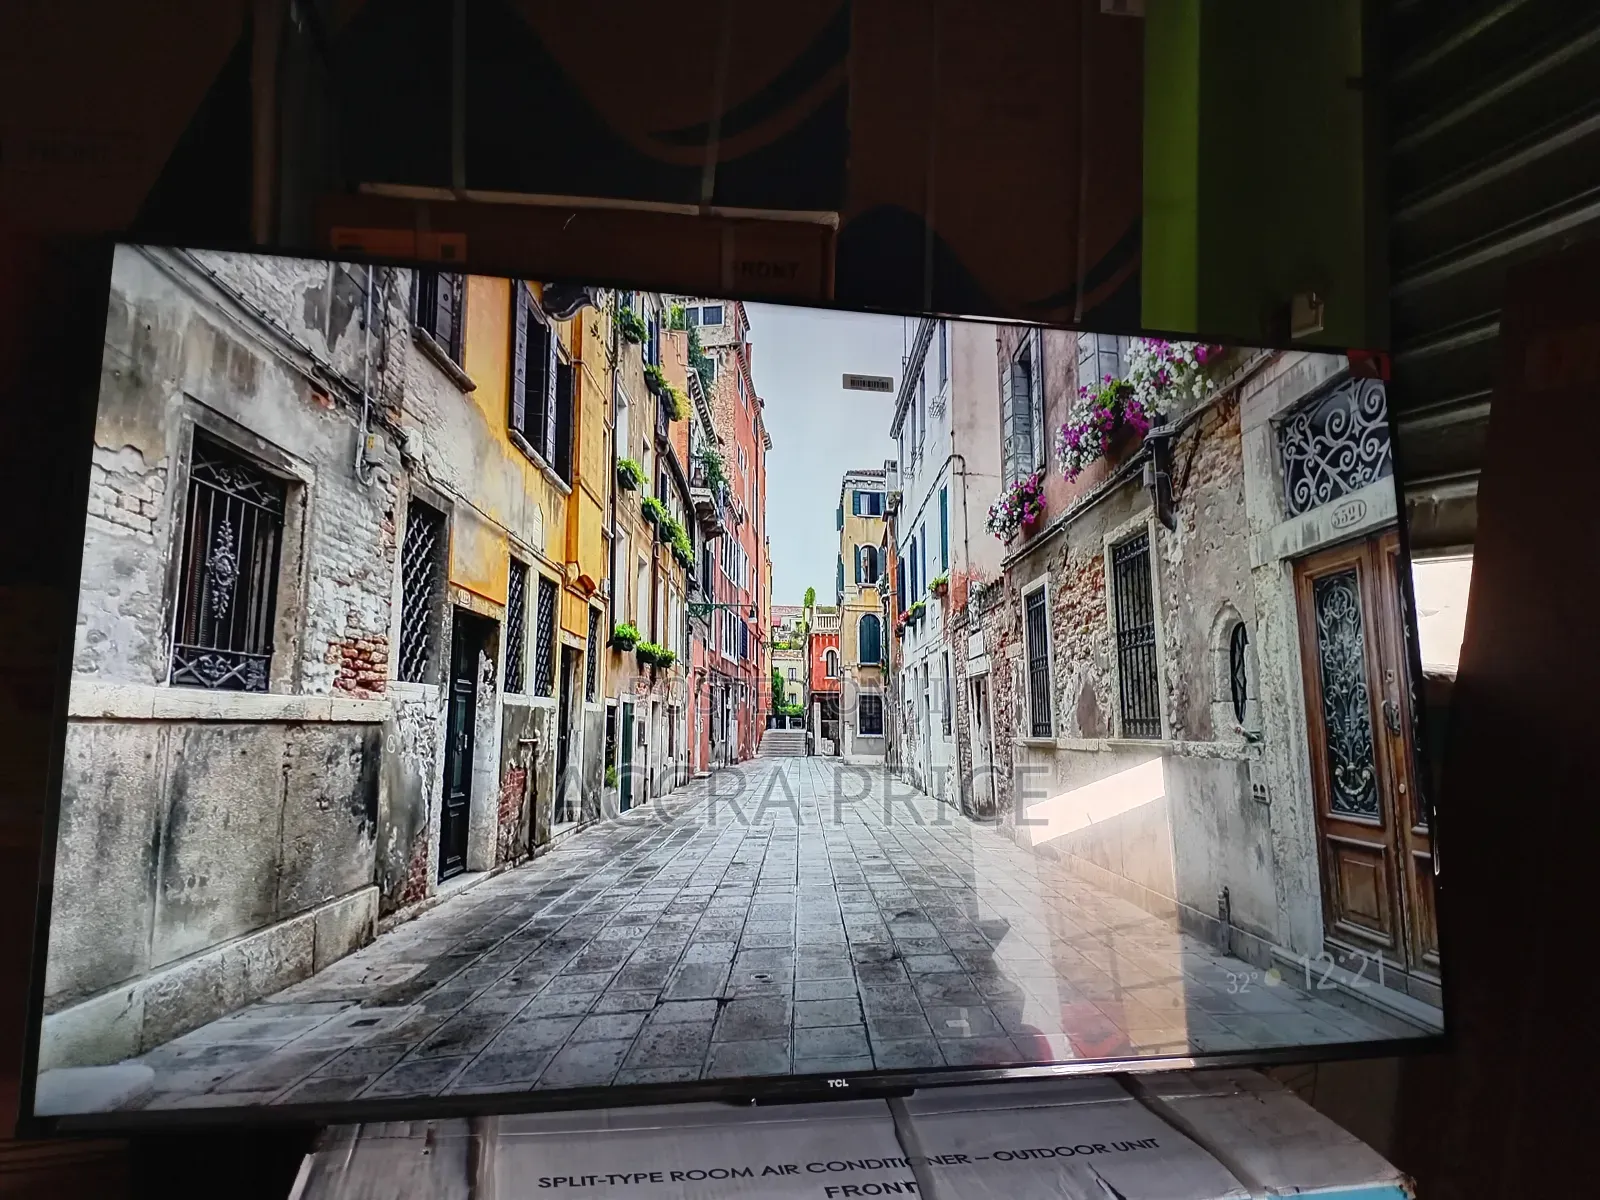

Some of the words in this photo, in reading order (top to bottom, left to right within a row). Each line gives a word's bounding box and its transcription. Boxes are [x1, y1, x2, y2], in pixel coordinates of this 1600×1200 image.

[1299, 949, 1386, 991] 12:21
[827, 1078, 849, 1088] TCL
[538, 1171, 664, 1189] SPLIT-TYPE
[671, 1166, 754, 1183] ROOM
[761, 1163, 801, 1178] AIR
[993, 1143, 1111, 1162] OUTDOOR
[1113, 1138, 1162, 1153] UNIT
[824, 1181, 918, 1199] FRONT
